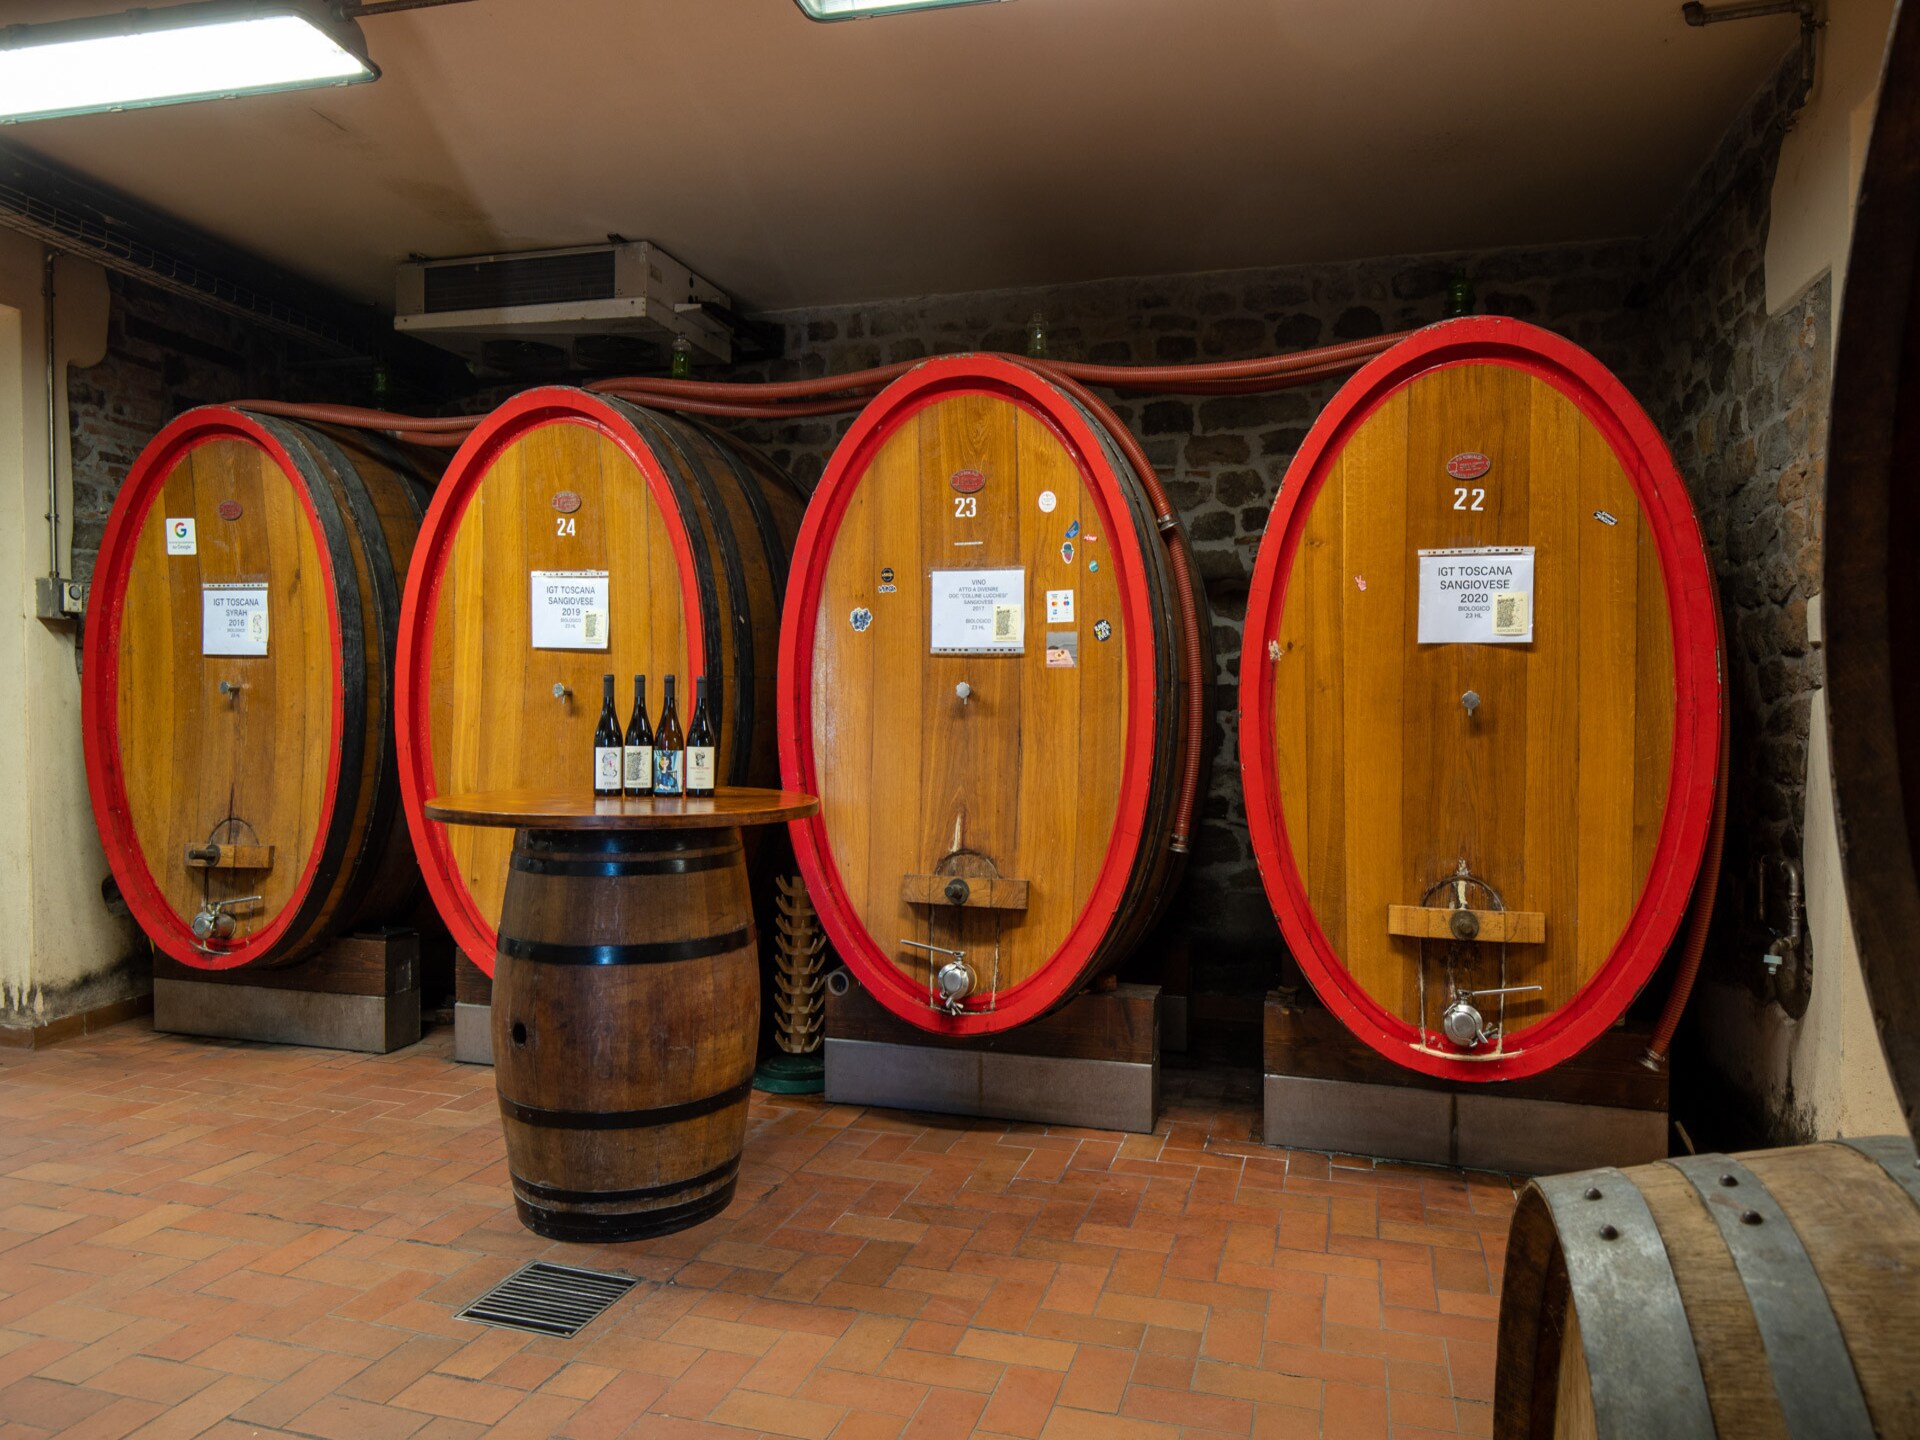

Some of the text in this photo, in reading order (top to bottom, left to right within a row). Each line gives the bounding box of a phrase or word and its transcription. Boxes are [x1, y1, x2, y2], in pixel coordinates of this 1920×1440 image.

[1453, 487, 1485, 511] 22
[954, 497, 977, 517] 23
[556, 518, 576, 536] 24
[1438, 566, 1512, 576] IGT TOSCANA
[546, 585, 595, 594] IGT TOSCANA
[1440, 579, 1510, 590] SANGIOVESE
[213, 598, 259, 606] IGT TOSCANA
[548, 597, 594, 605] SANGIOVESE
[1460, 593, 1489, 603] 2020
[562, 608, 580, 616] 2019
